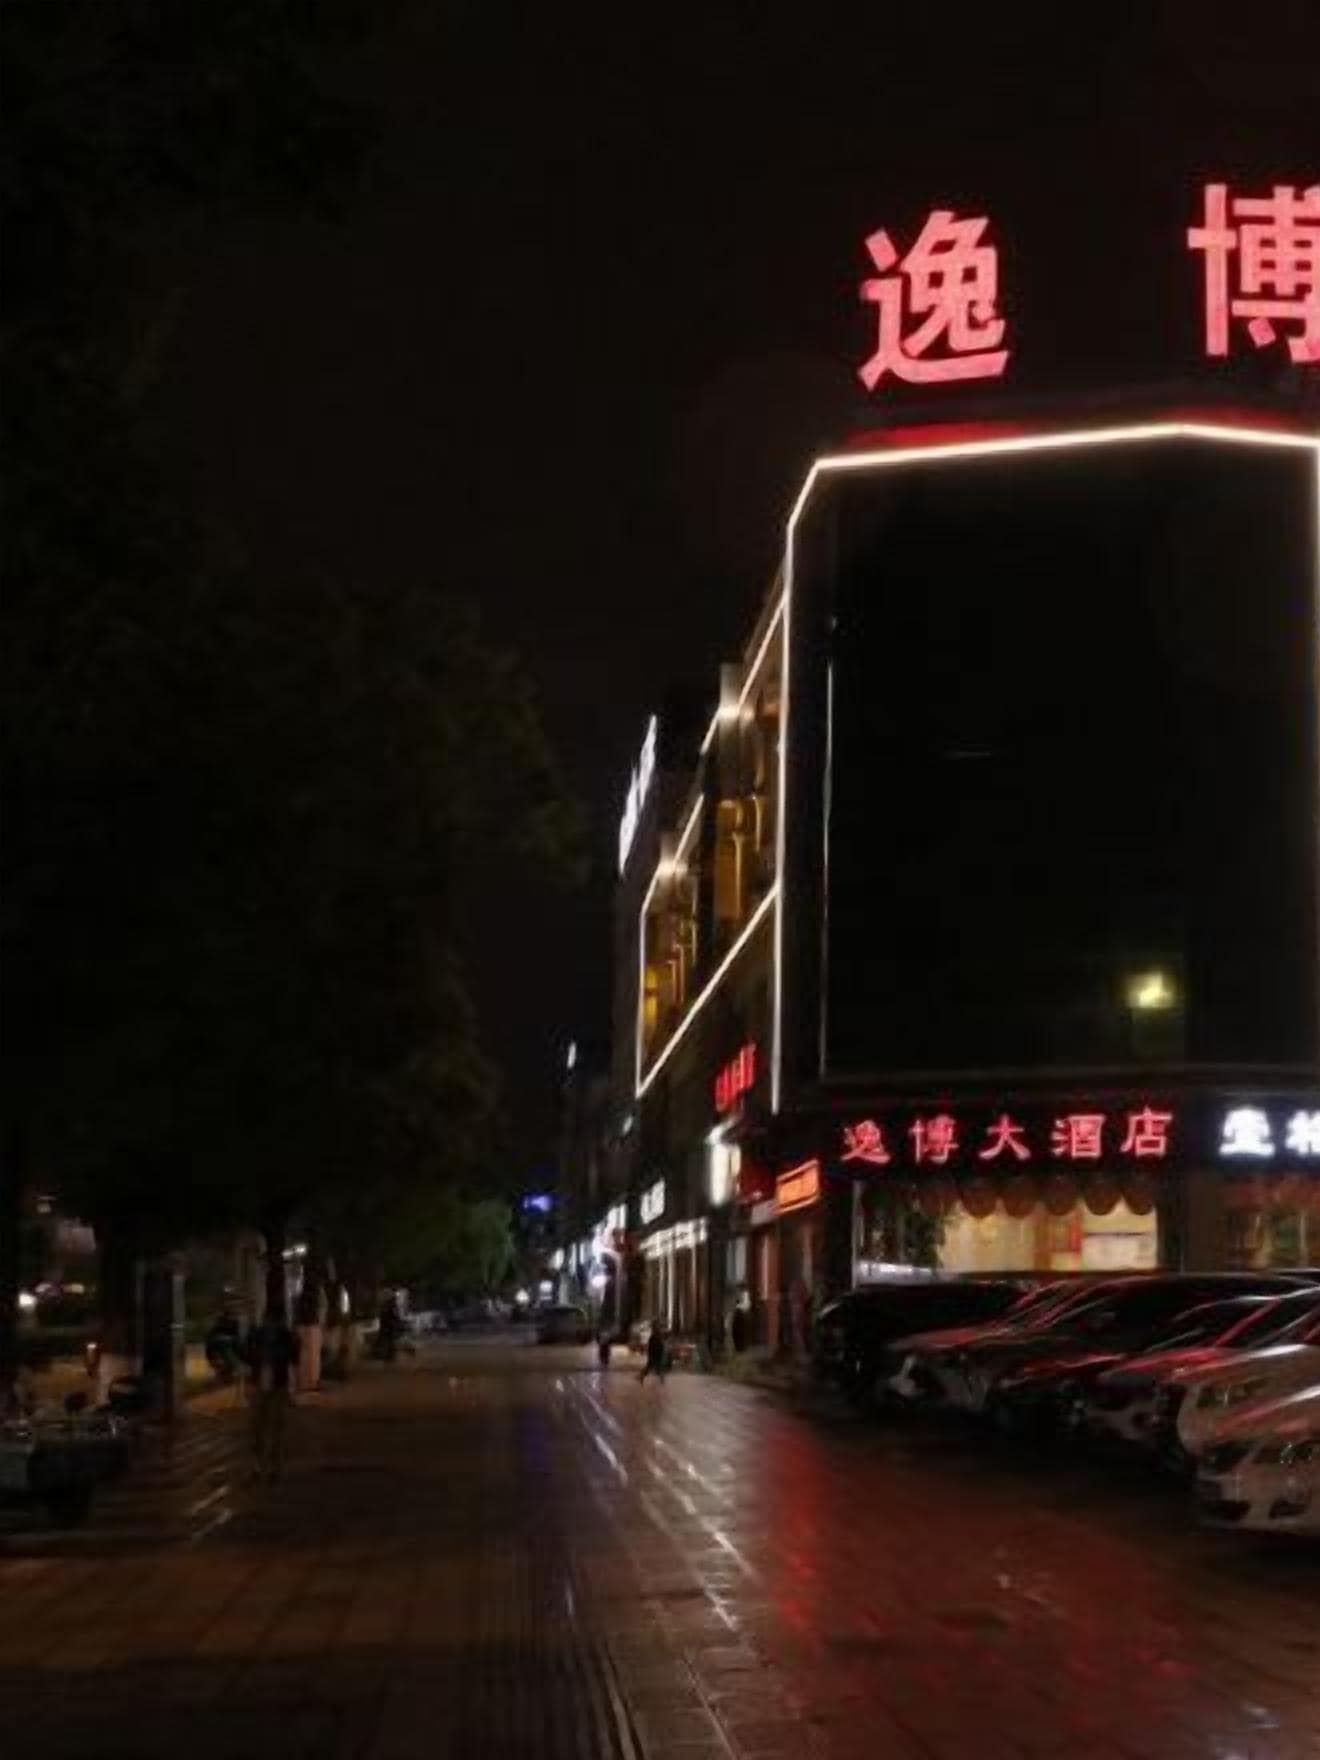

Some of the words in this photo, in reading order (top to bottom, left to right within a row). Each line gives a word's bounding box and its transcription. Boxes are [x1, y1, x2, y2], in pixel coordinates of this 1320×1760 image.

[840, 1106, 1174, 1165] 逸博大酒店
